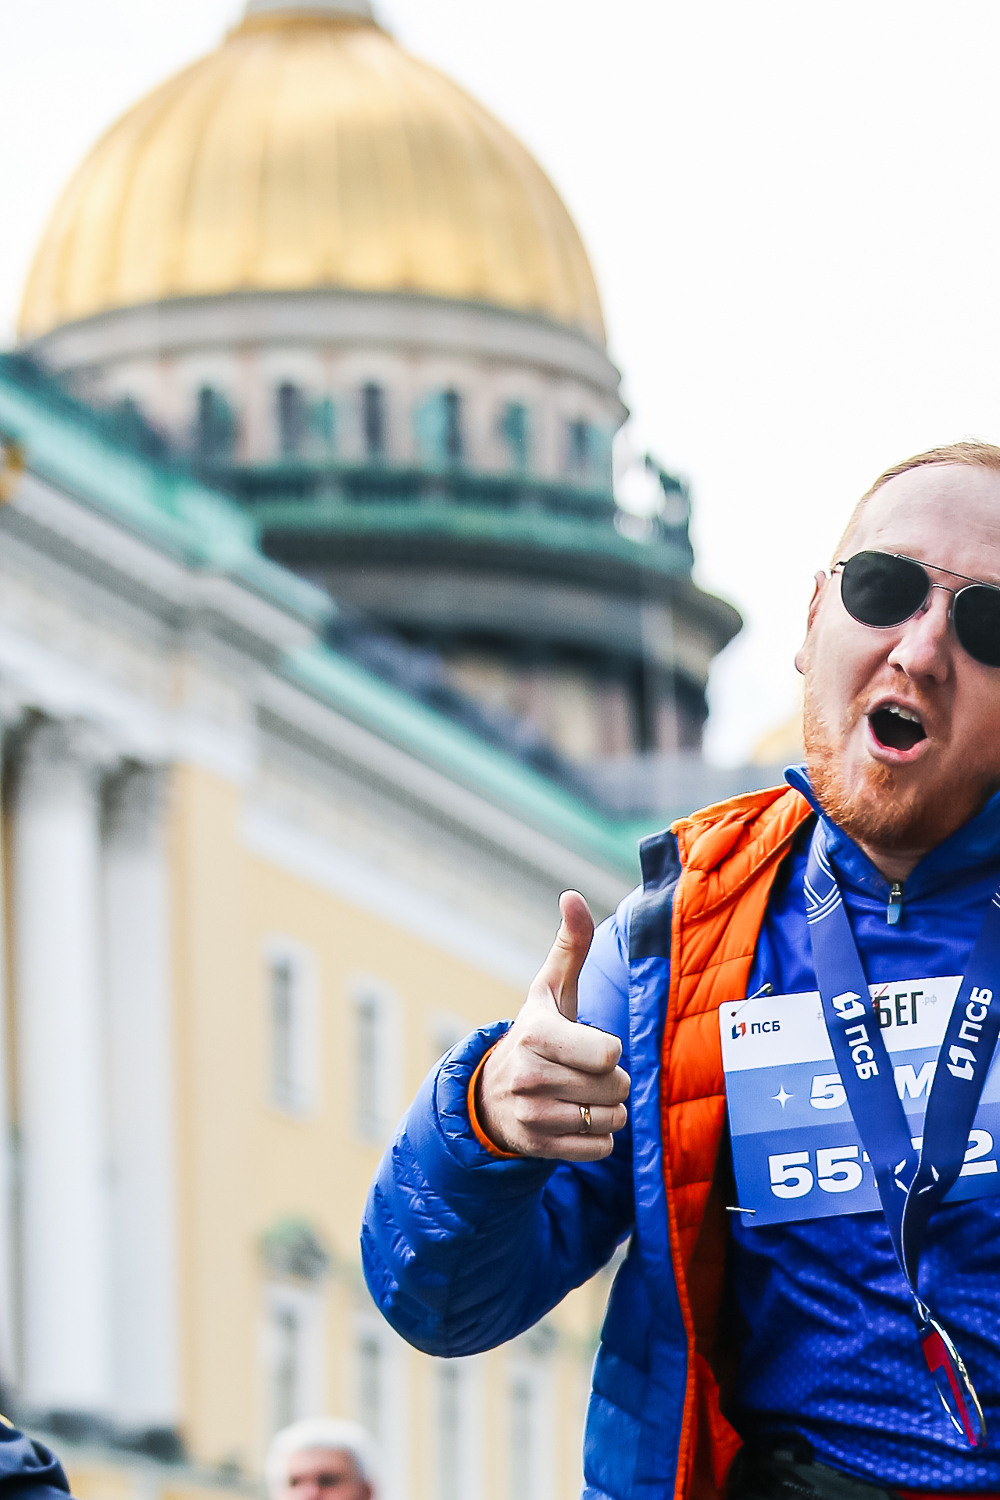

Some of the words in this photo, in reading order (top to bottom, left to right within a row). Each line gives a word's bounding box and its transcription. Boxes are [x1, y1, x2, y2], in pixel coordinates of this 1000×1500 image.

[751, 1020, 781, 1035] ПСБ
[959, 986, 994, 1043] ПСБ
[844, 1022, 880, 1081] ПСБ
[768, 1129, 998, 1199] 552
